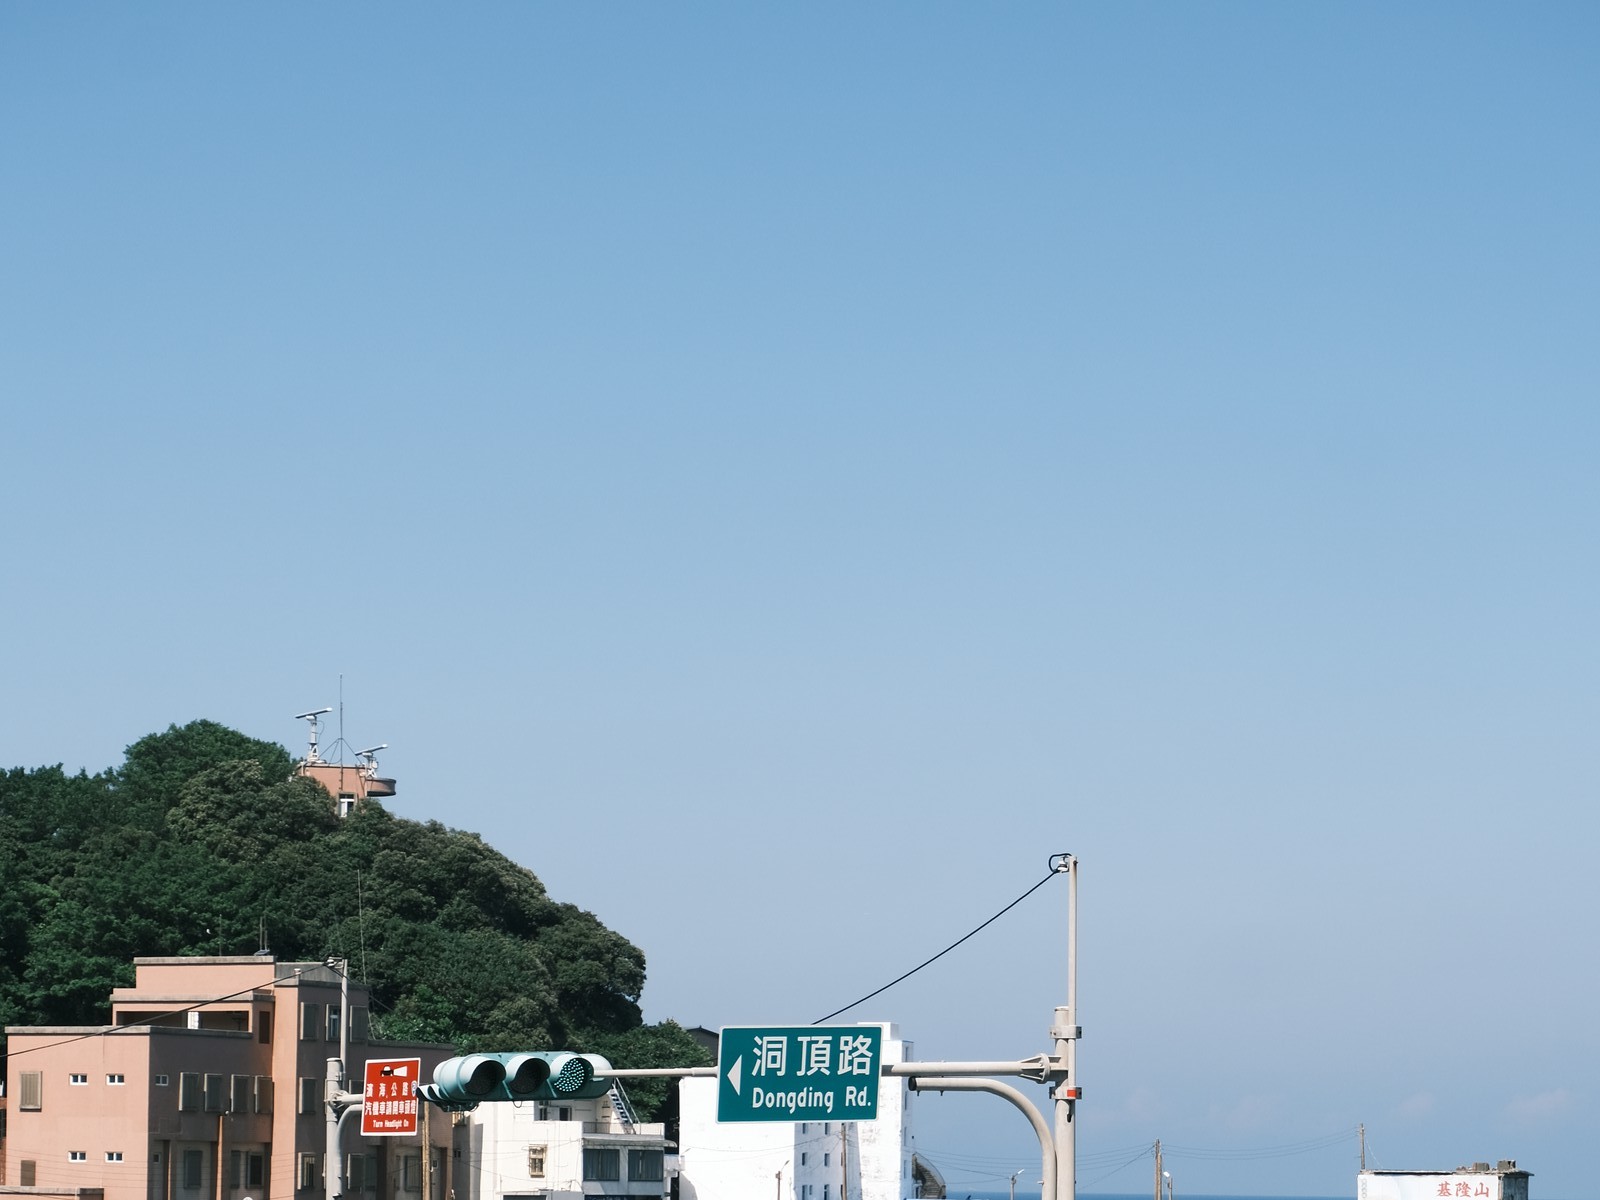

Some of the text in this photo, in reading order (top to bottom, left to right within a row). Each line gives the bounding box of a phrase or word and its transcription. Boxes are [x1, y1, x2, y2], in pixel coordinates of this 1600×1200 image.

[752, 1034, 873, 1077] 洞頂路
[752, 1085, 872, 1114] Dongding Rd.
[373, 1119, 383, 1128] Turn
[1437, 1180, 1490, 1198] 基隆山
